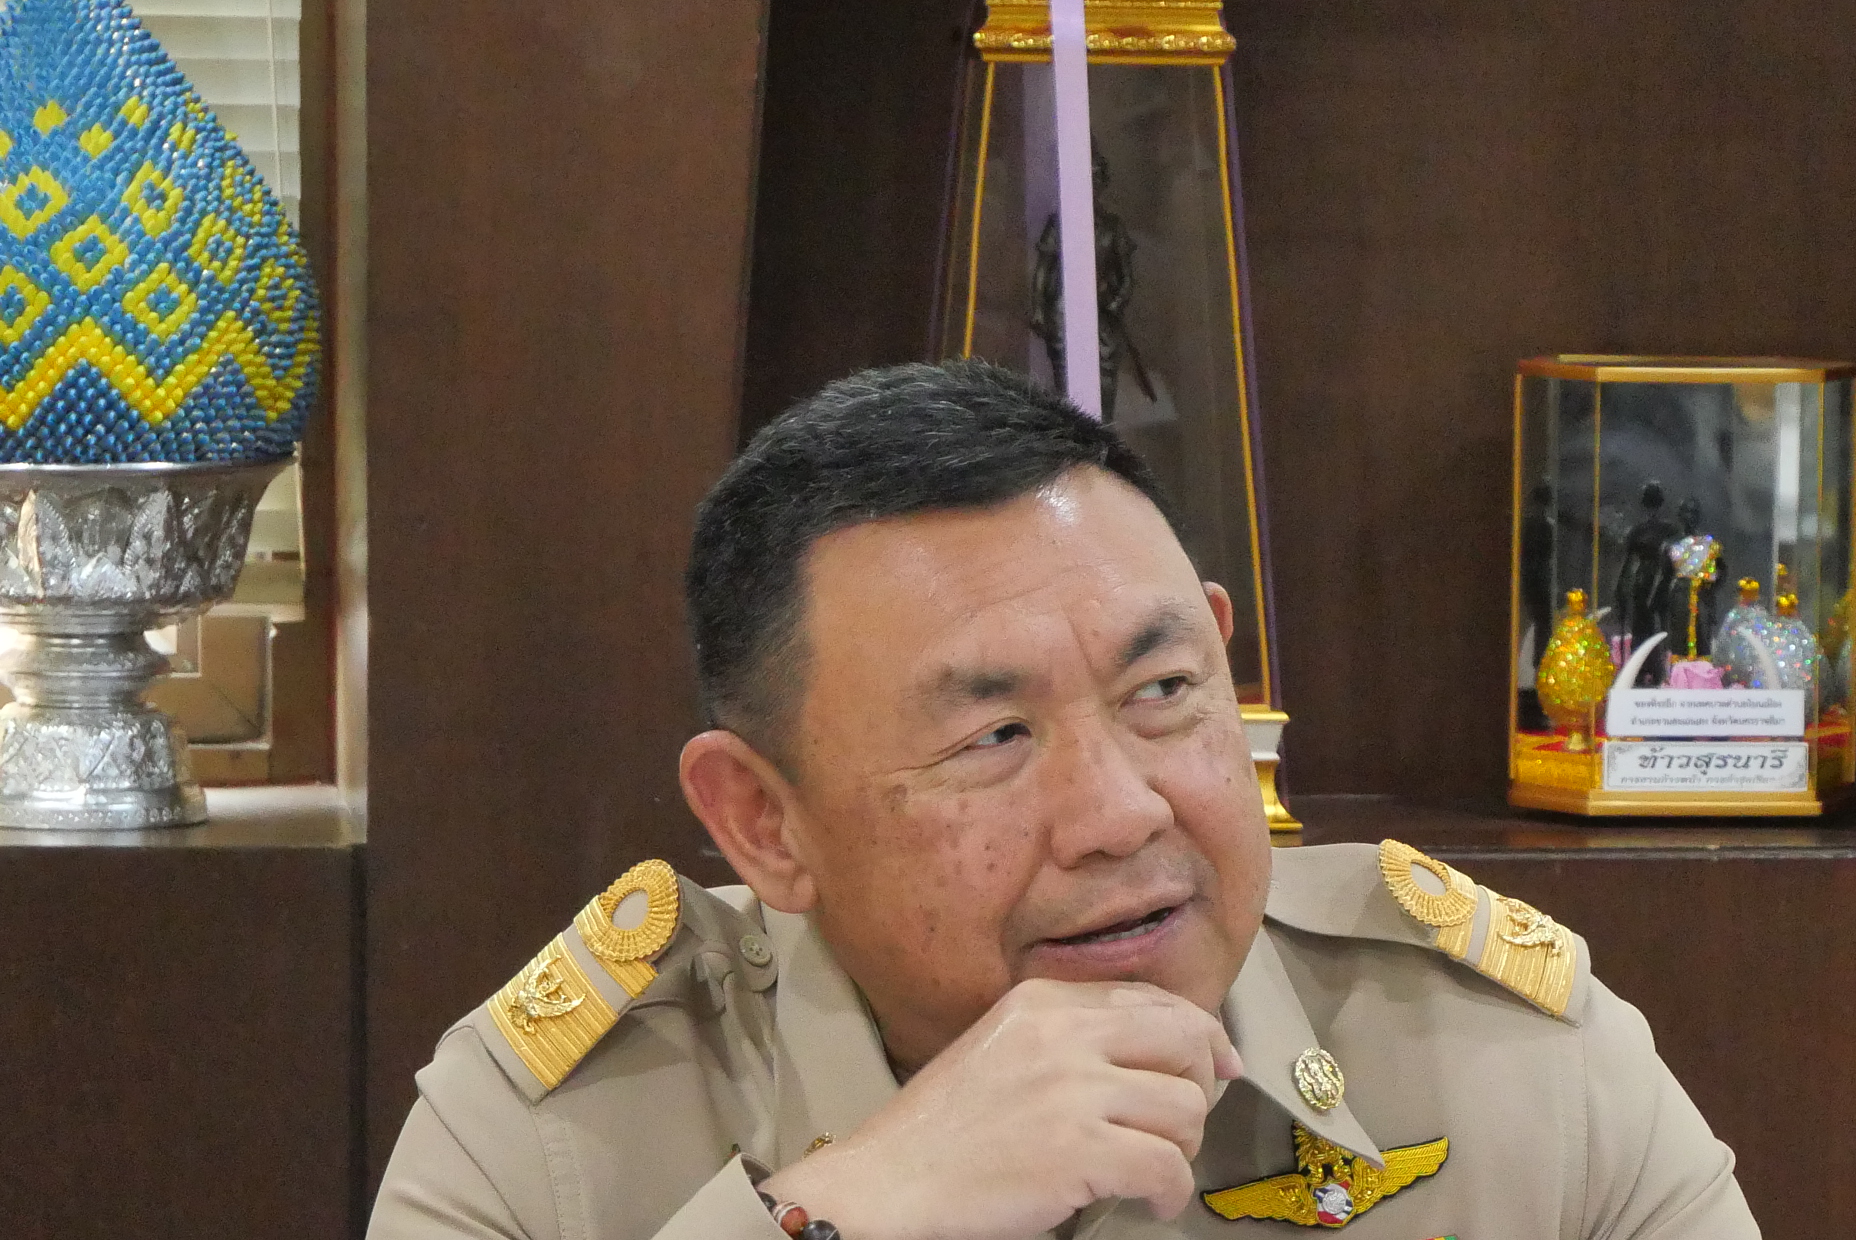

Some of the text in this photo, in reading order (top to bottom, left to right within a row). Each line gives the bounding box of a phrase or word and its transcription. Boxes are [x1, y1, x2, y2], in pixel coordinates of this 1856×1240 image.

[1638, 747, 1789, 776] ท้าวสุรนารี
